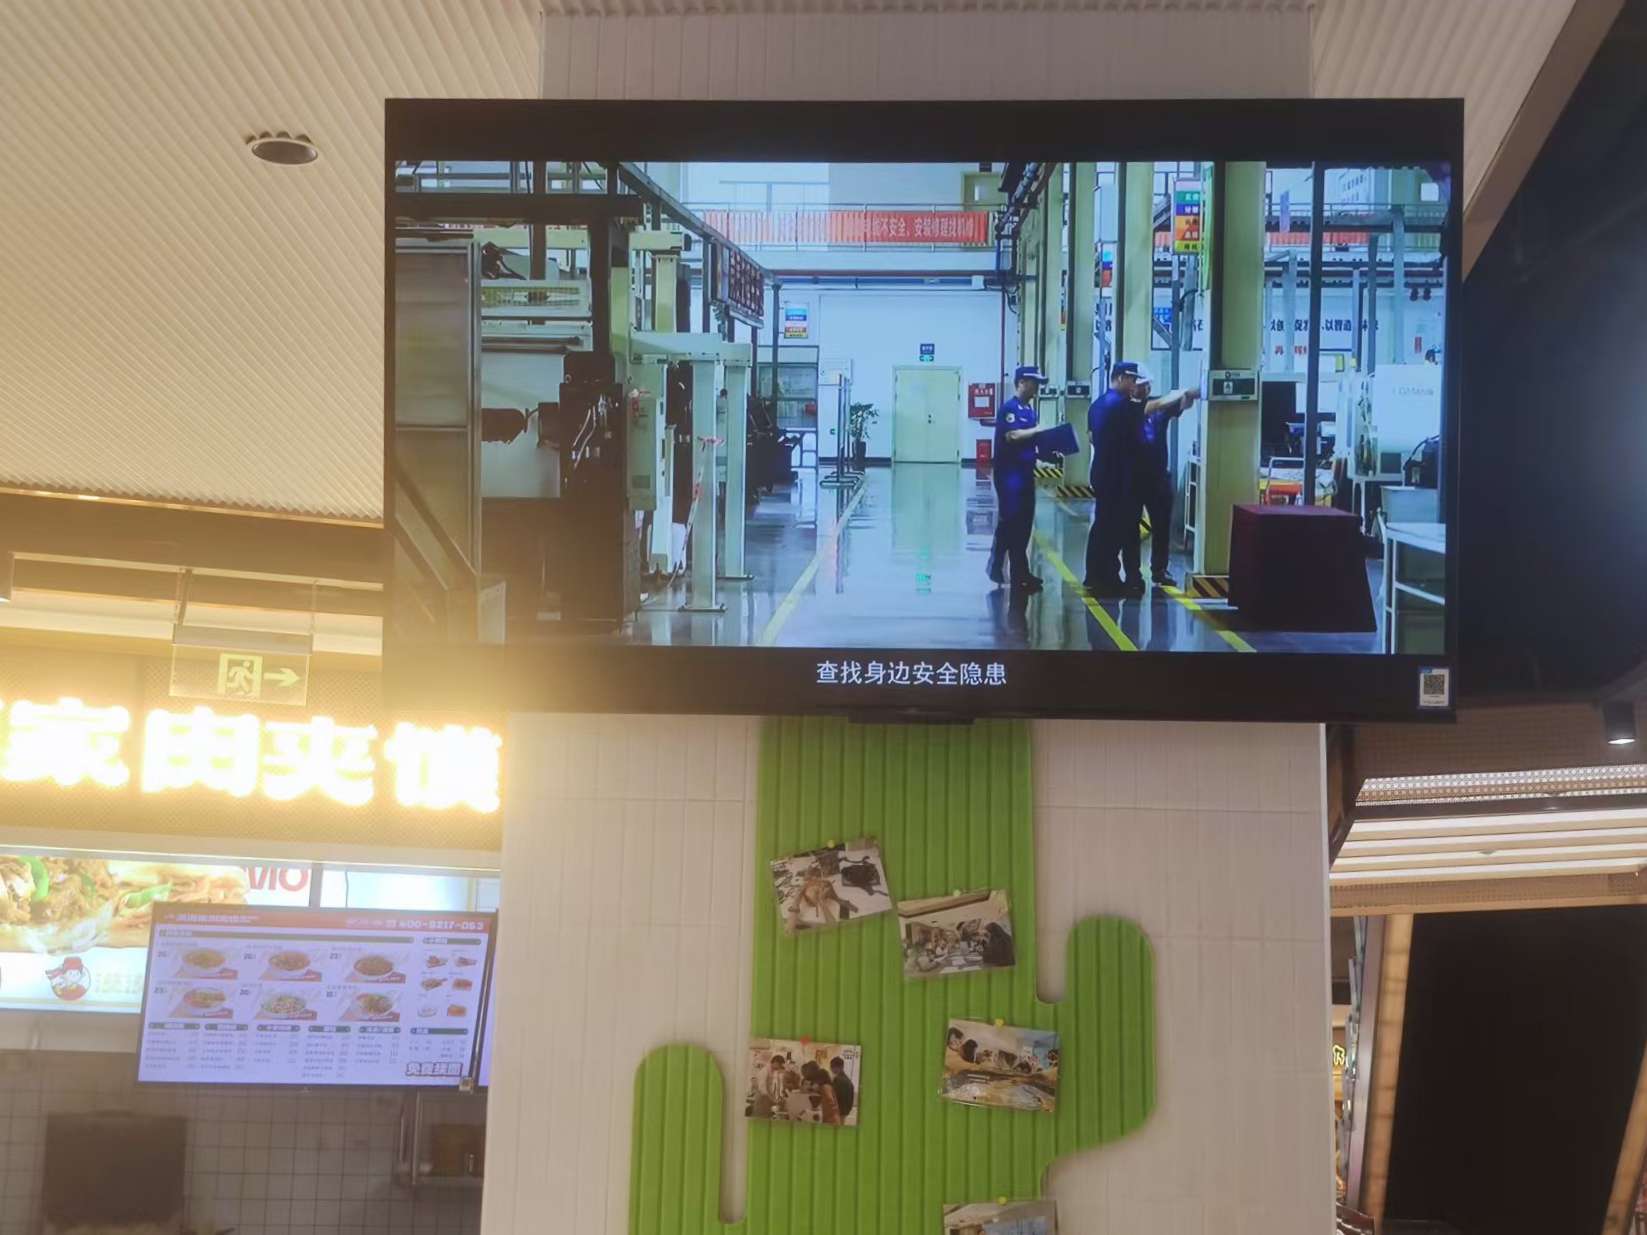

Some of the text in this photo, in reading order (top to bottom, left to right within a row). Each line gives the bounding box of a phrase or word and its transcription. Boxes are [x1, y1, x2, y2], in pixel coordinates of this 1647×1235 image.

[816, 660, 1007, 686] 查找身边安全隐患
